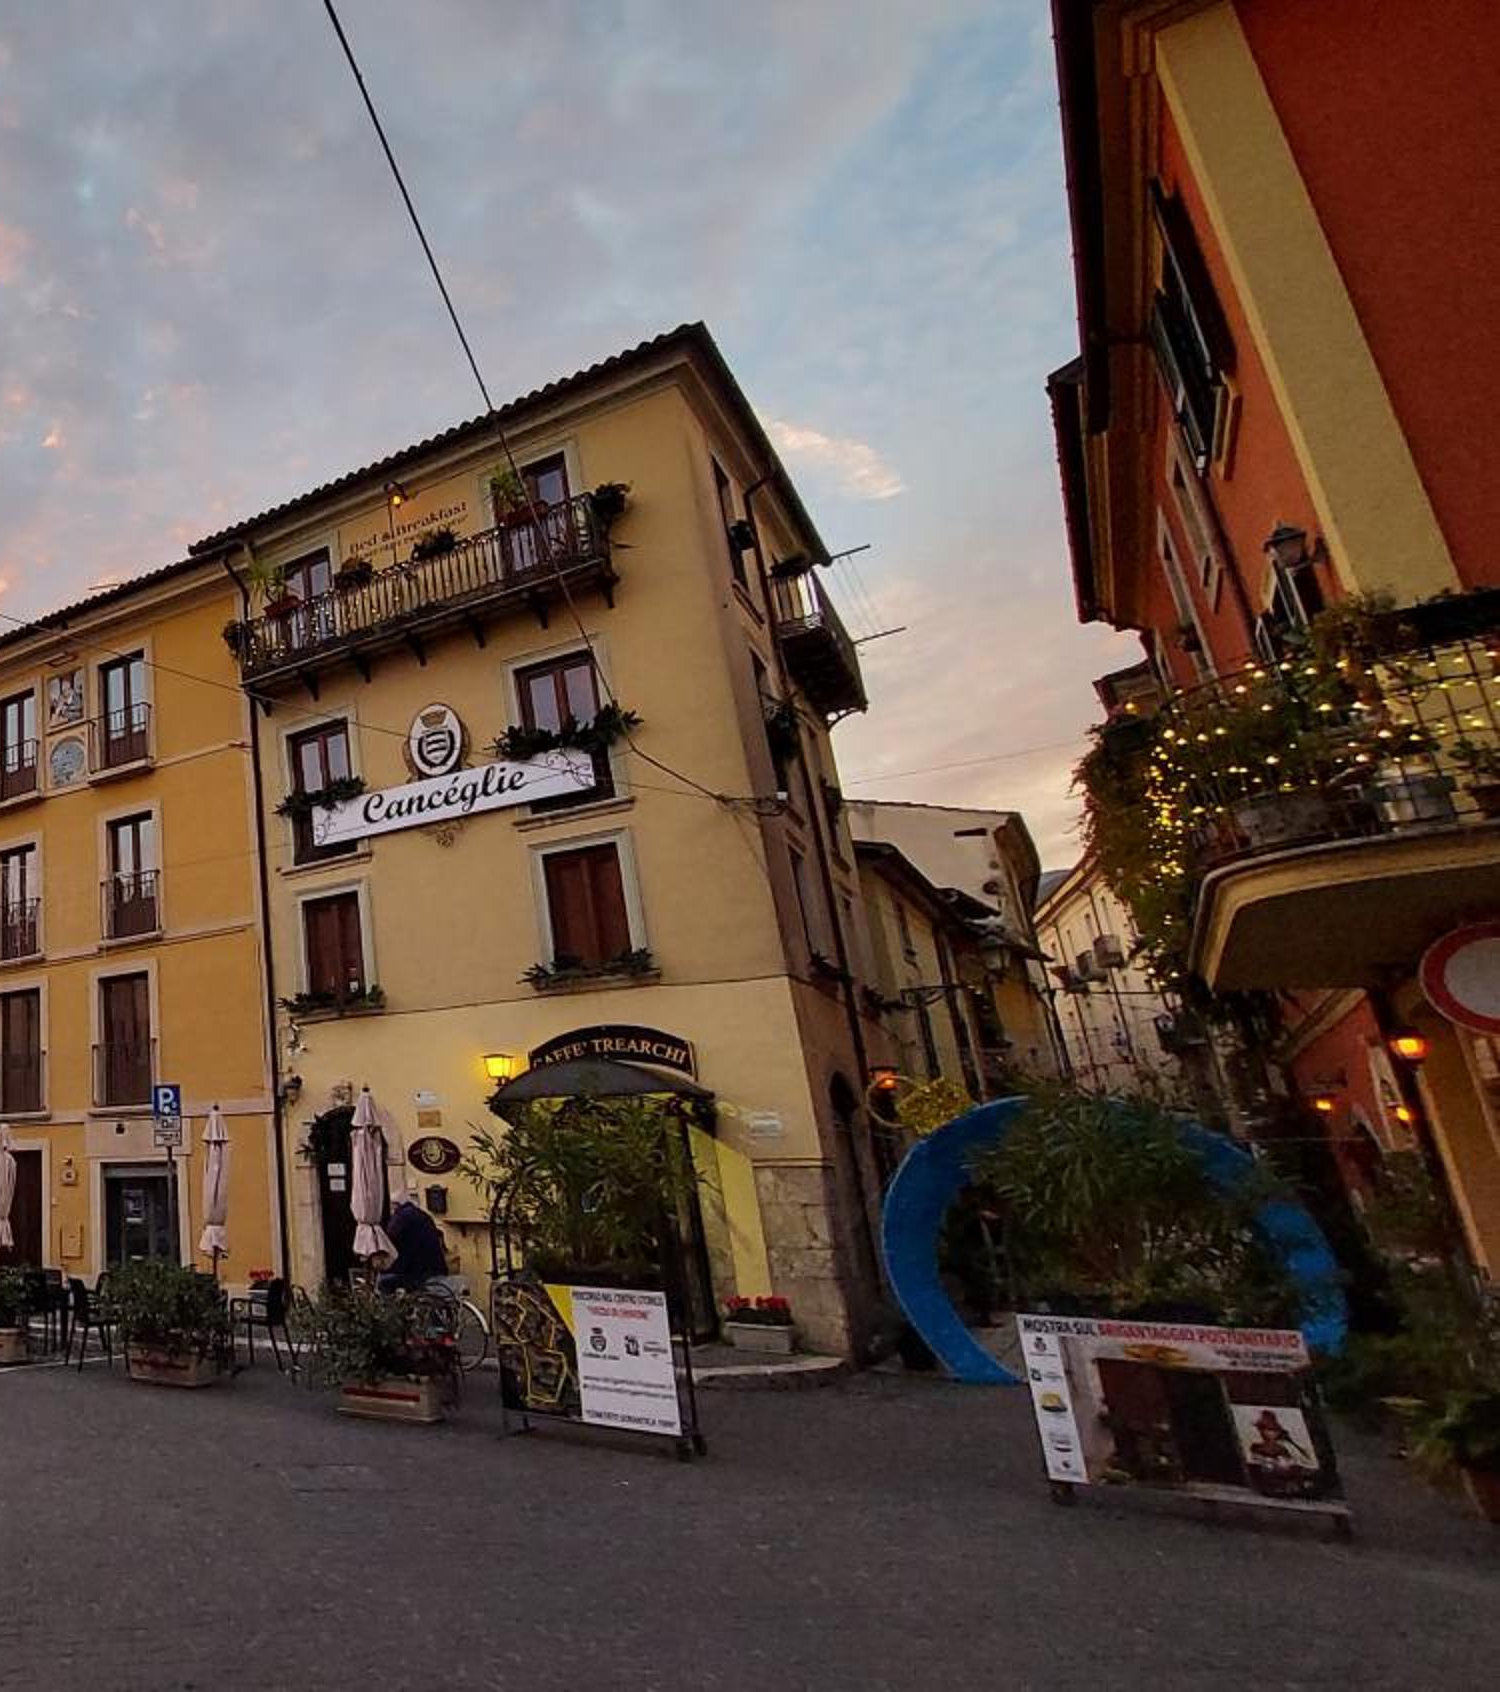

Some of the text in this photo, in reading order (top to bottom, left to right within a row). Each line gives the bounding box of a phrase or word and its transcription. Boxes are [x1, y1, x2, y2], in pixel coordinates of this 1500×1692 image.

[362, 765, 526, 824] Cancéglie
[590, 1038, 687, 1064] TREARCHI
[158, 1088, 175, 1113] P
[1023, 1319, 1072, 1334] MOSTRA
